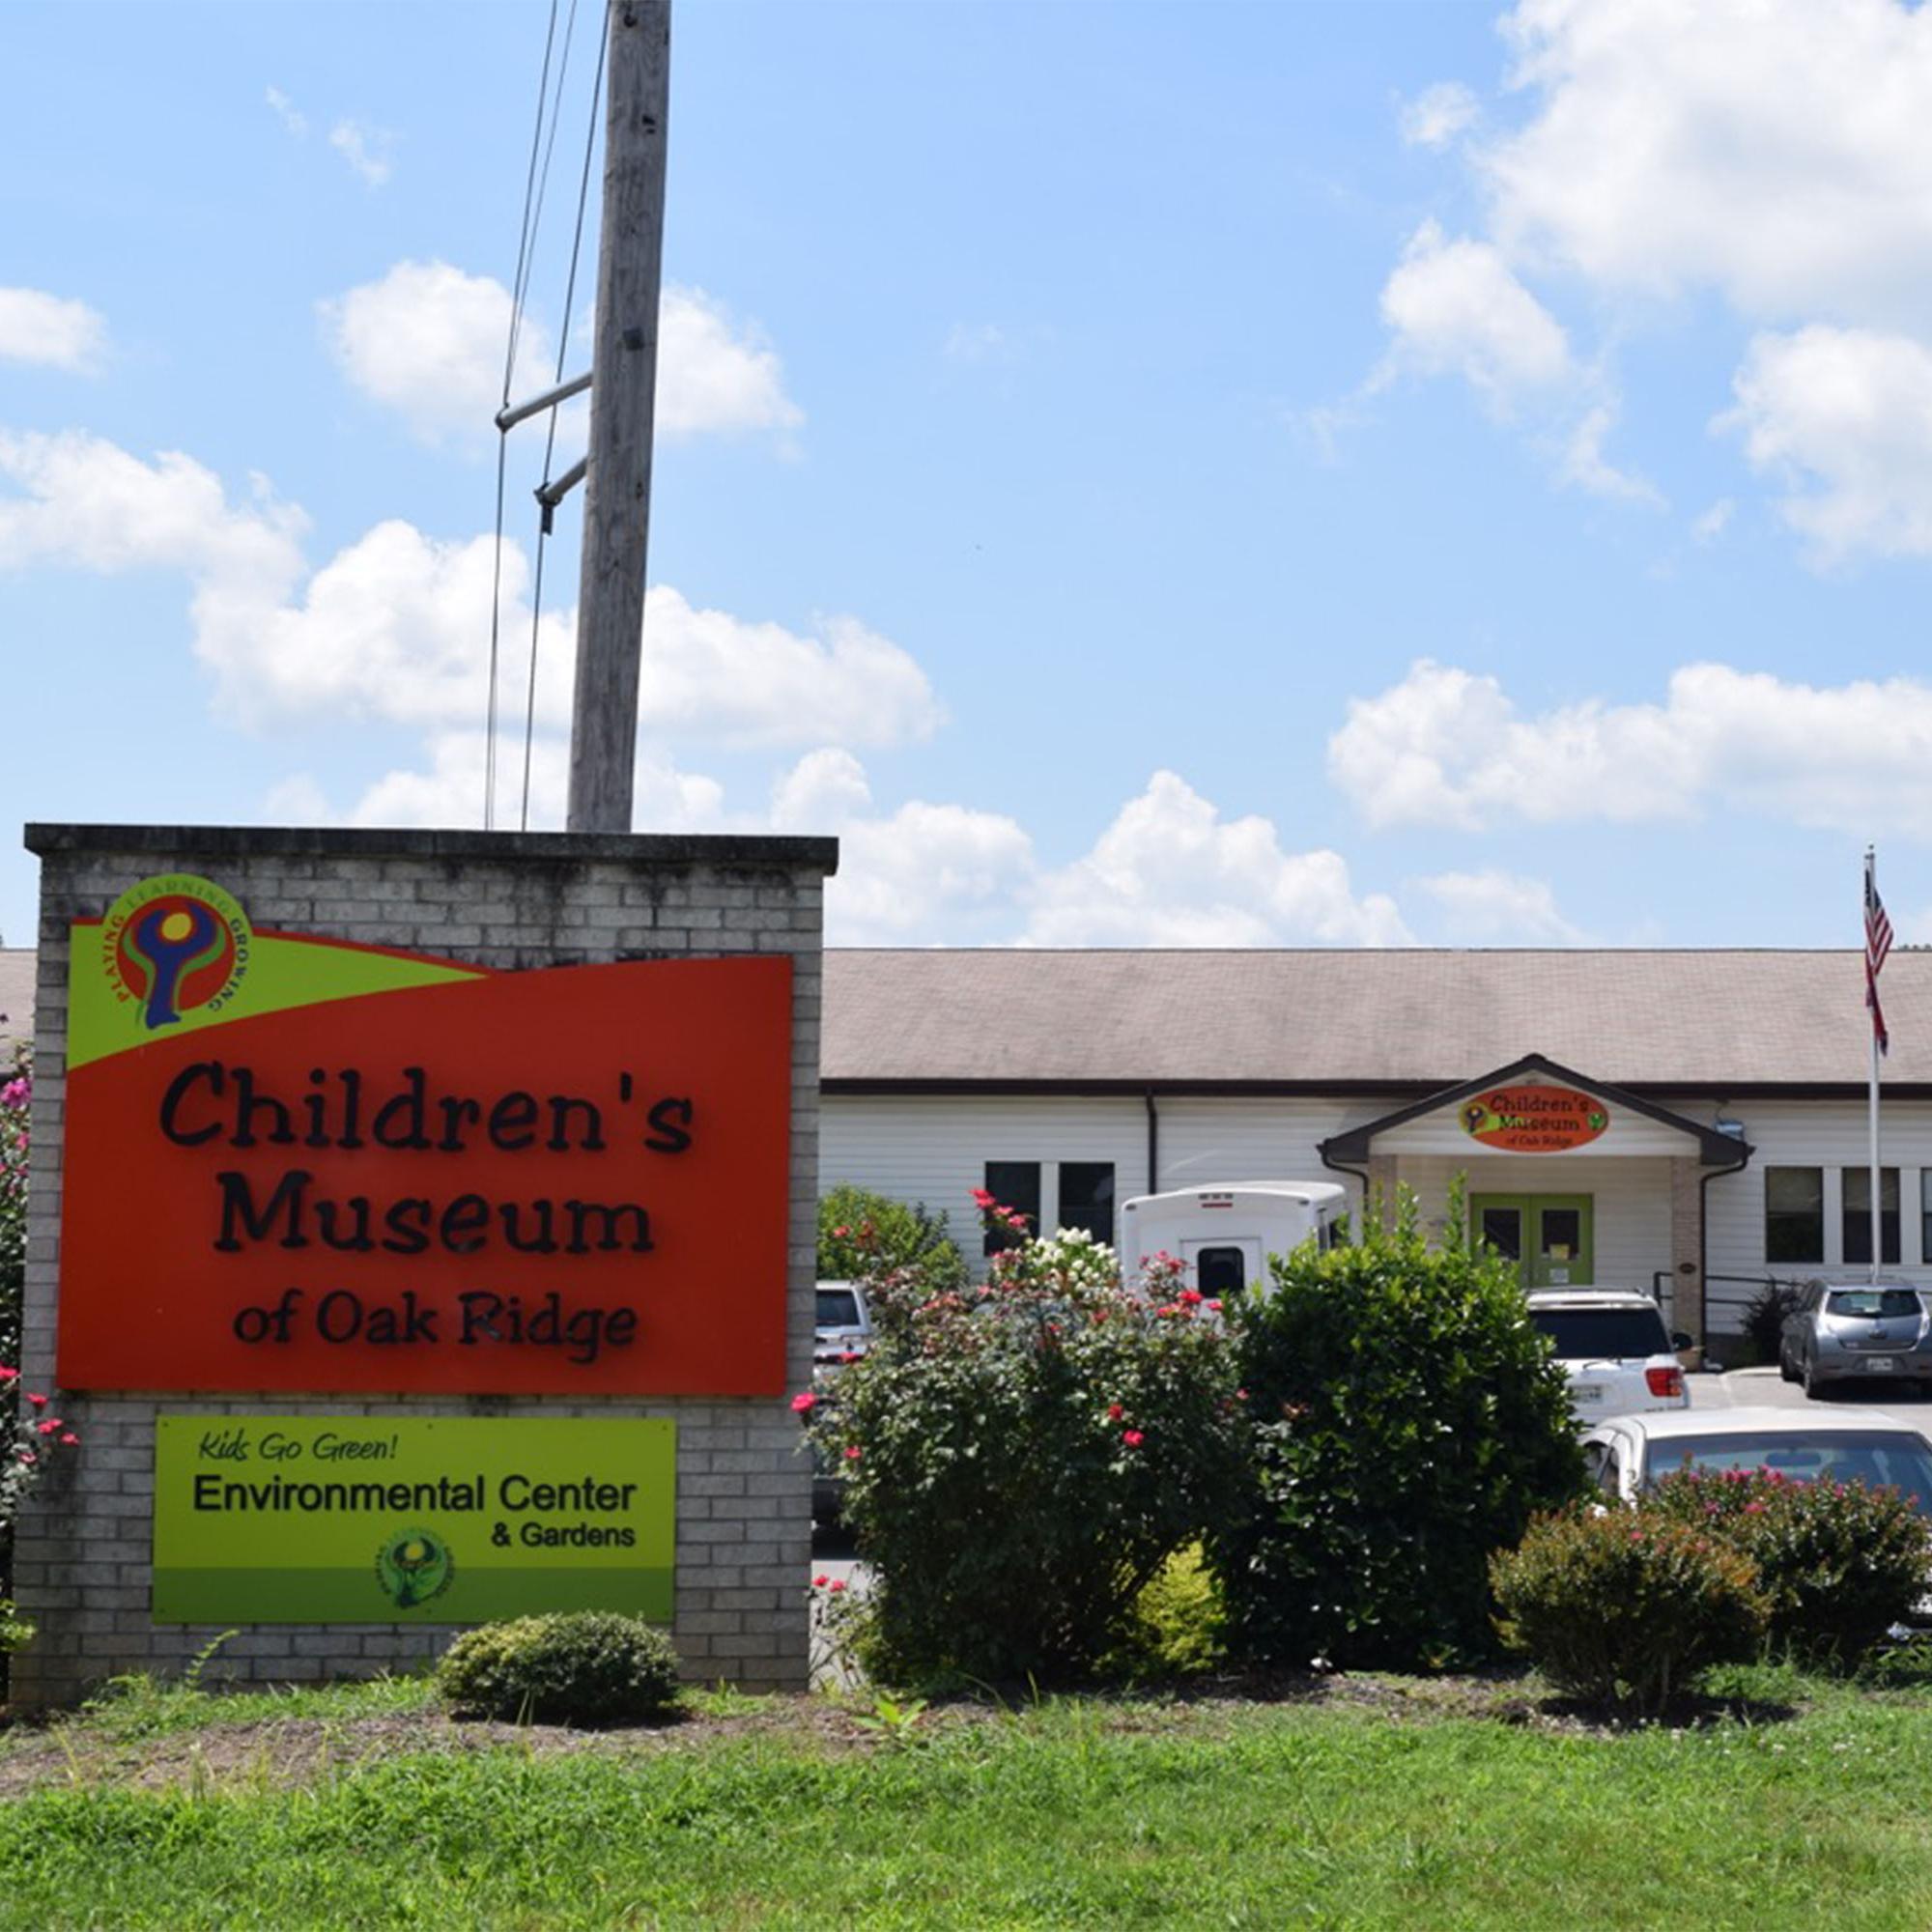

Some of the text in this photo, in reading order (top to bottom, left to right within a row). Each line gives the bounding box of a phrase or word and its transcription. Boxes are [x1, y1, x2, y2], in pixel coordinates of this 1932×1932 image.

[102, 915, 130, 1003] PLAYING
[208, 918, 249, 1011] GROWING
[158, 1061, 694, 1152] Children's
[1490, 1094, 1589, 1112] Children's
[1498, 1114, 1580, 1131] Museum
[213, 1170, 655, 1254] Museum
[233, 1288, 638, 1364] of Oak Ridge
[199, 1428, 398, 1462] Kids Go Green!
[194, 1474, 638, 1512] Environmental Center
[491, 1522, 636, 1547] & Gardens
